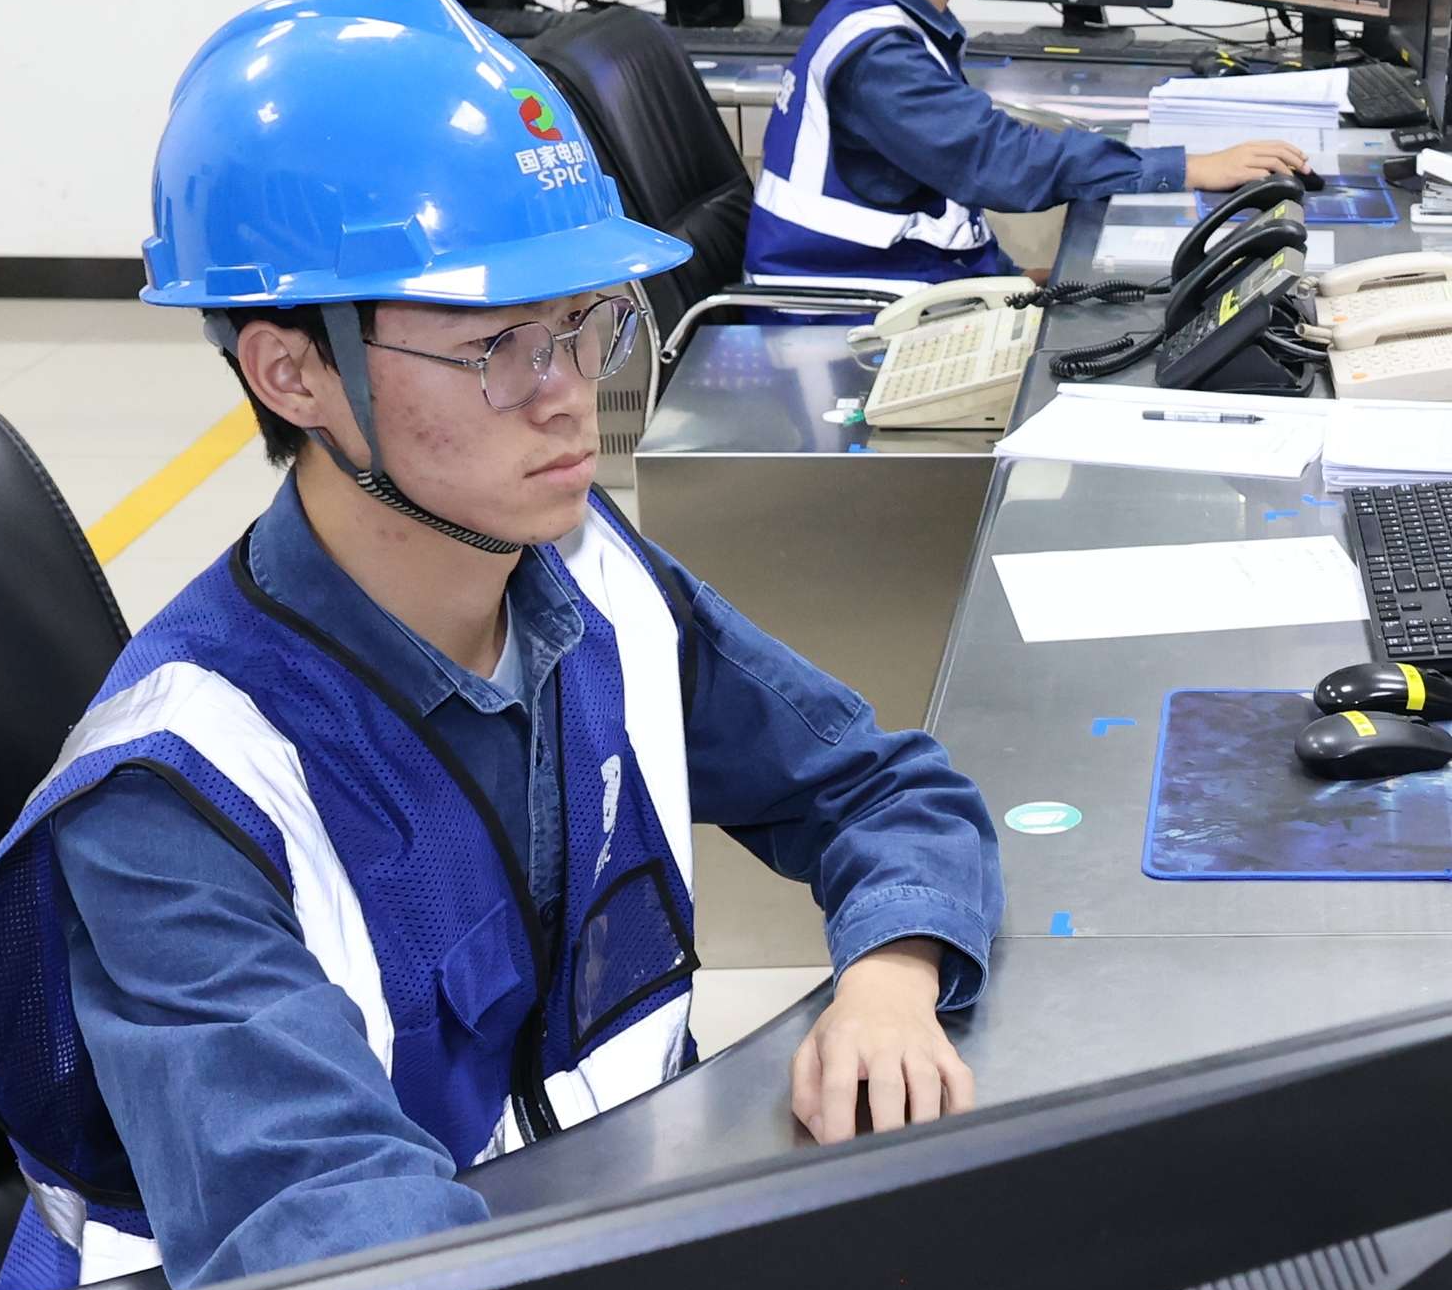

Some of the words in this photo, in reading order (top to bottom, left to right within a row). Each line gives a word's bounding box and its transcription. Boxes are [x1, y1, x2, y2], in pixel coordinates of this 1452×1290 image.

[515, 141, 587, 175] 国家电投
[538, 164, 587, 190] SPIC
